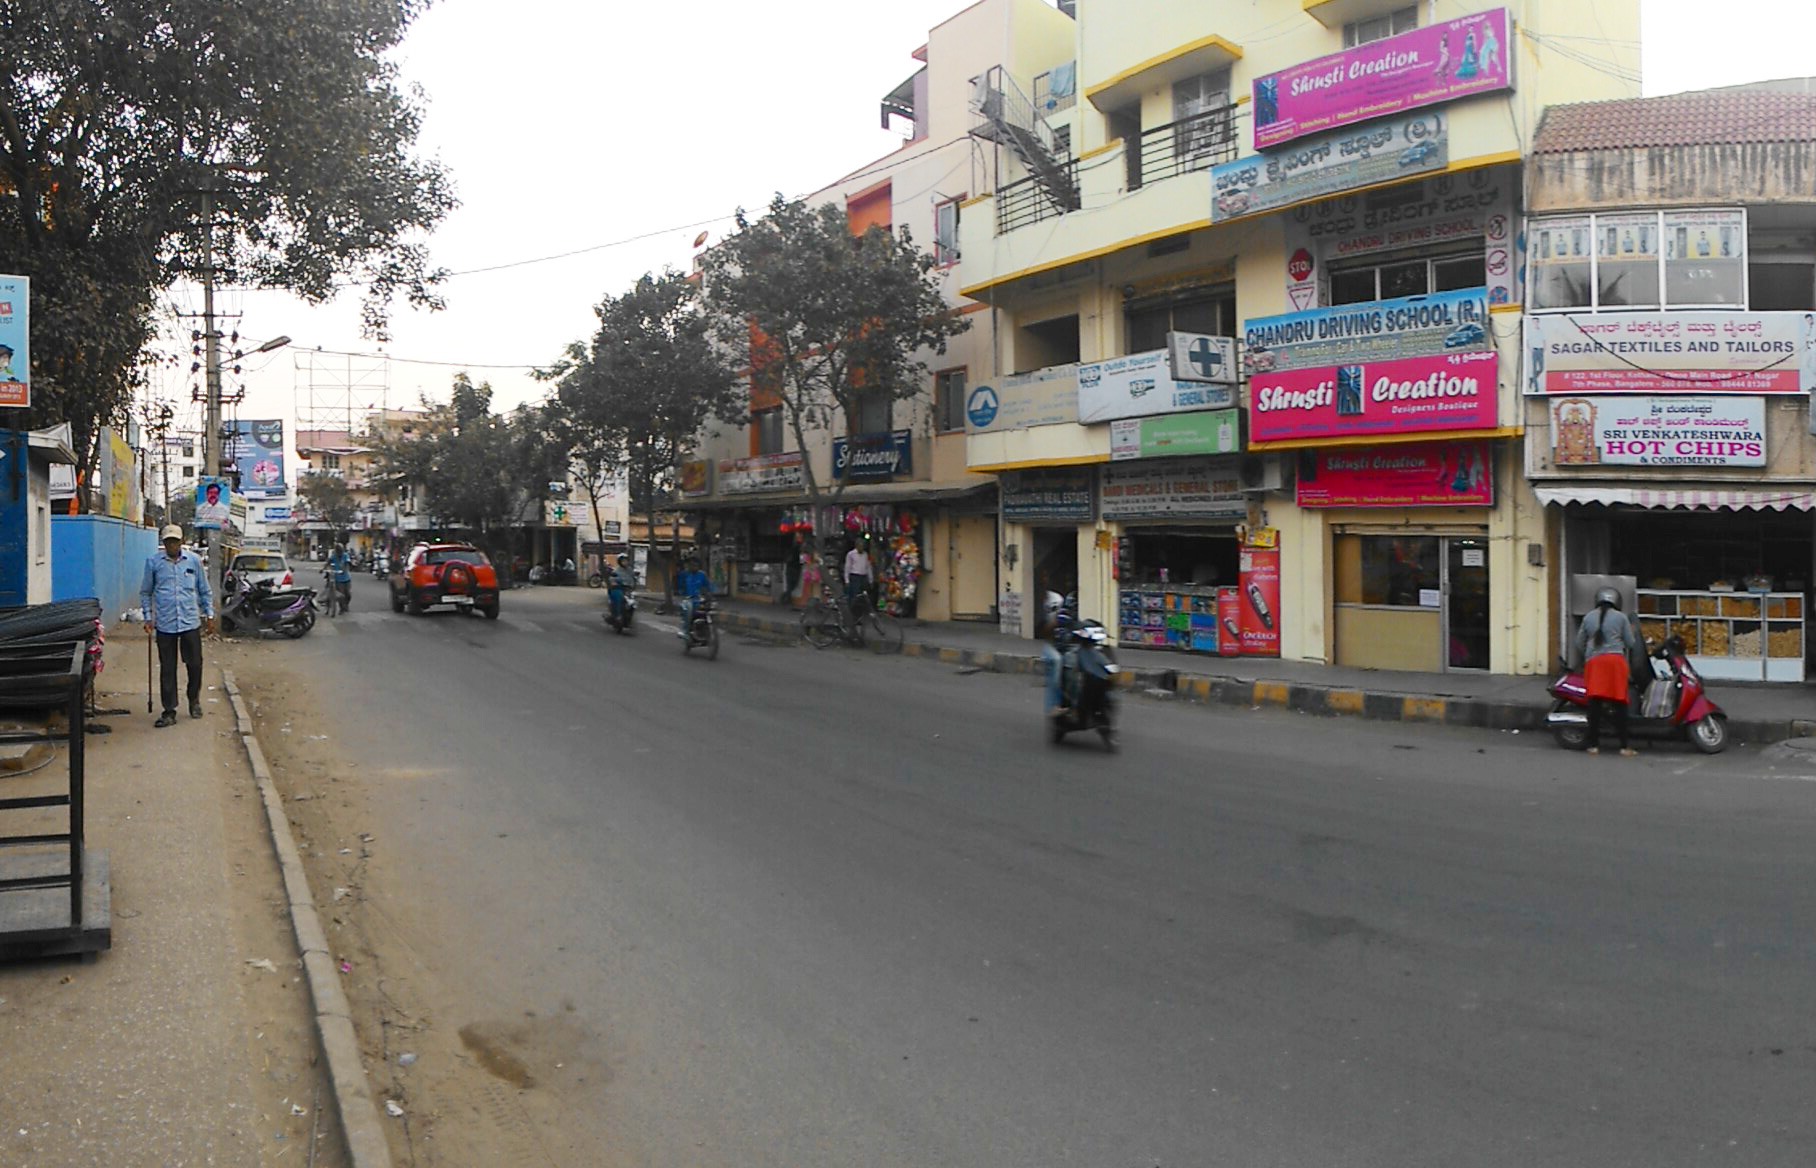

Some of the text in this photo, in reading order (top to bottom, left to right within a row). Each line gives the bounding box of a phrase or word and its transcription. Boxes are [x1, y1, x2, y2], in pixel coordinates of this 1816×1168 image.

[1291, 65, 1344, 96] Shrusti
[1349, 49, 1419, 79] Creation
[1389, 226, 1431, 245] DRIVING
[1435, 218, 1476, 236] SCHOOL
[1246, 321, 1314, 348] CHANDRU
[1318, 311, 1381, 339] DRIVING
[1386, 303, 1452, 332] SCHOOL
[1551, 341, 1794, 356] SAGAR TEXTILES AND TAILORS
[1257, 371, 1478, 413] Shrusti Creation
[1603, 430, 1763, 441] SRI VENKATESHWARA
[1606, 441, 1762, 457] HOT CHIPS
[1373, 456, 1426, 470] Creation
[1640, 456, 1726, 464] & CONDIMENTS
